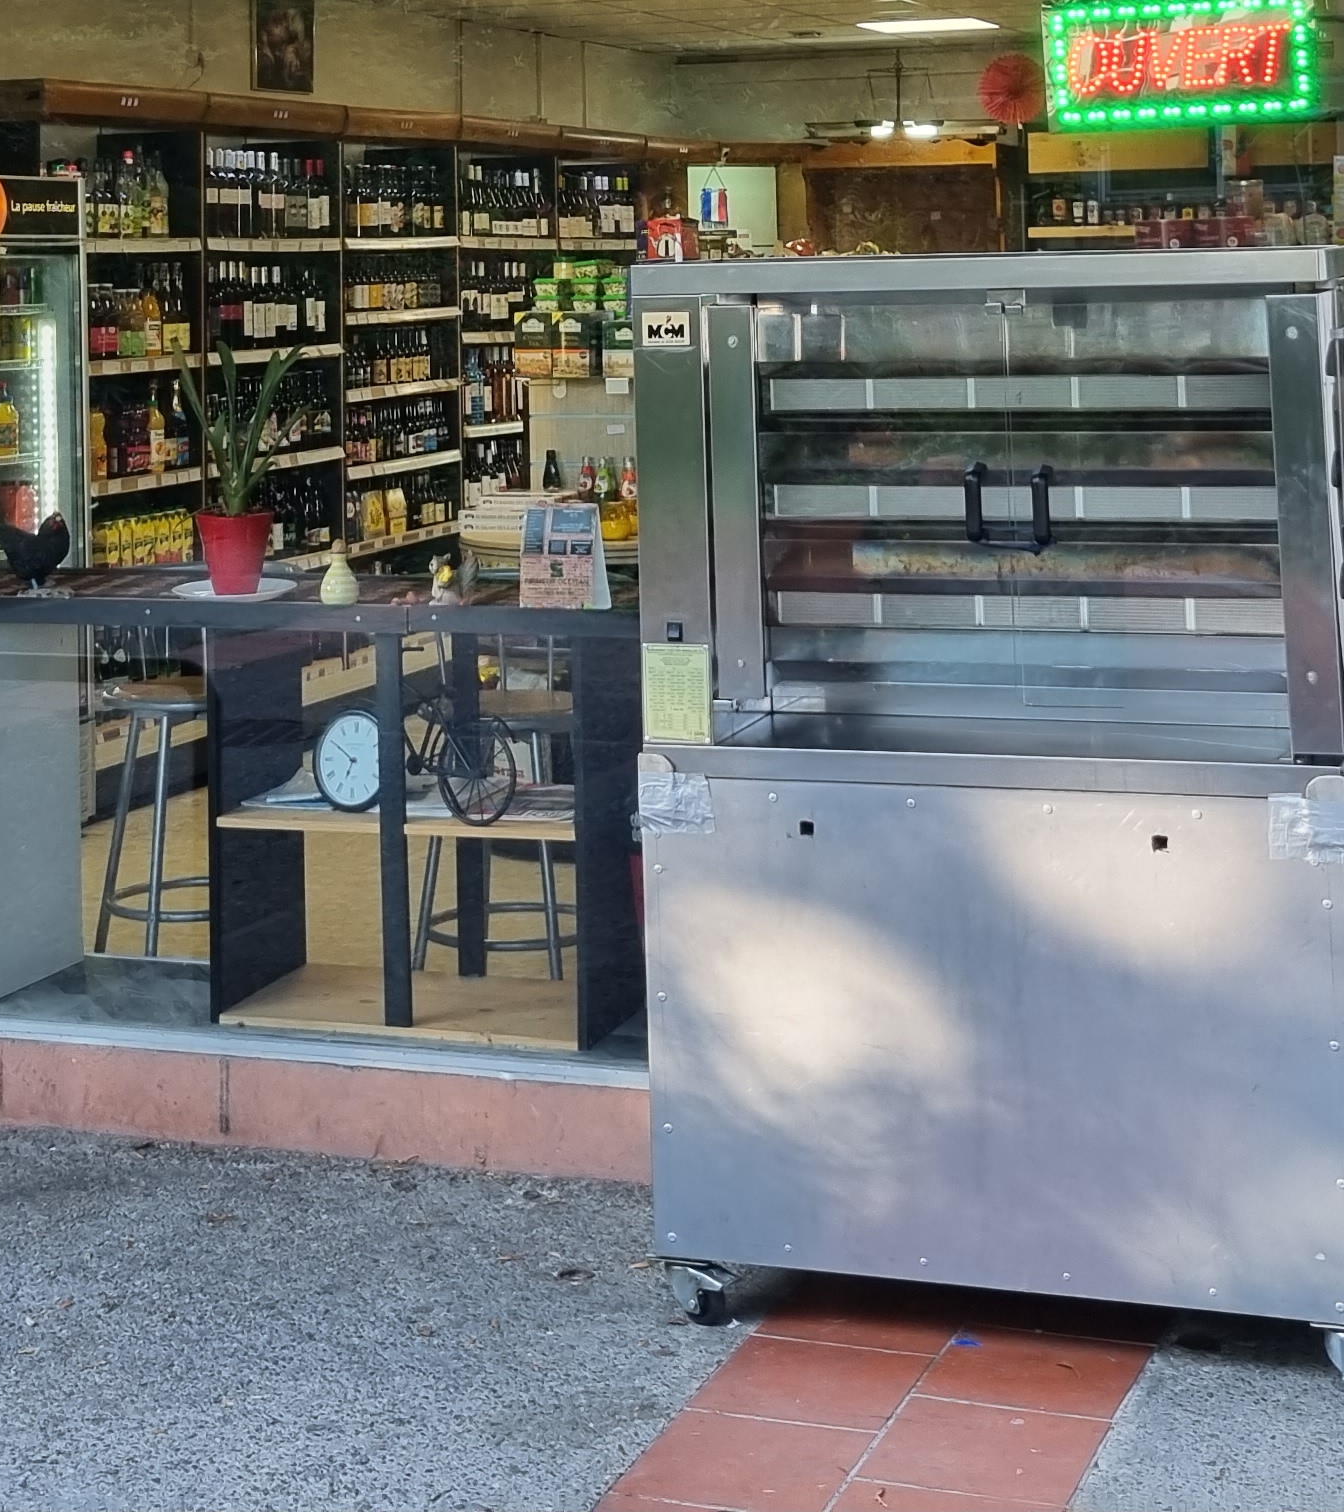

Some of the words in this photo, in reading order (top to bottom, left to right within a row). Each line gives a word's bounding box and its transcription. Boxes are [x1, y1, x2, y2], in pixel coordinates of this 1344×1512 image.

[1068, 23, 1292, 95] OUVERT
[10, 199, 21, 212] La
[22, 202, 45, 215] pause
